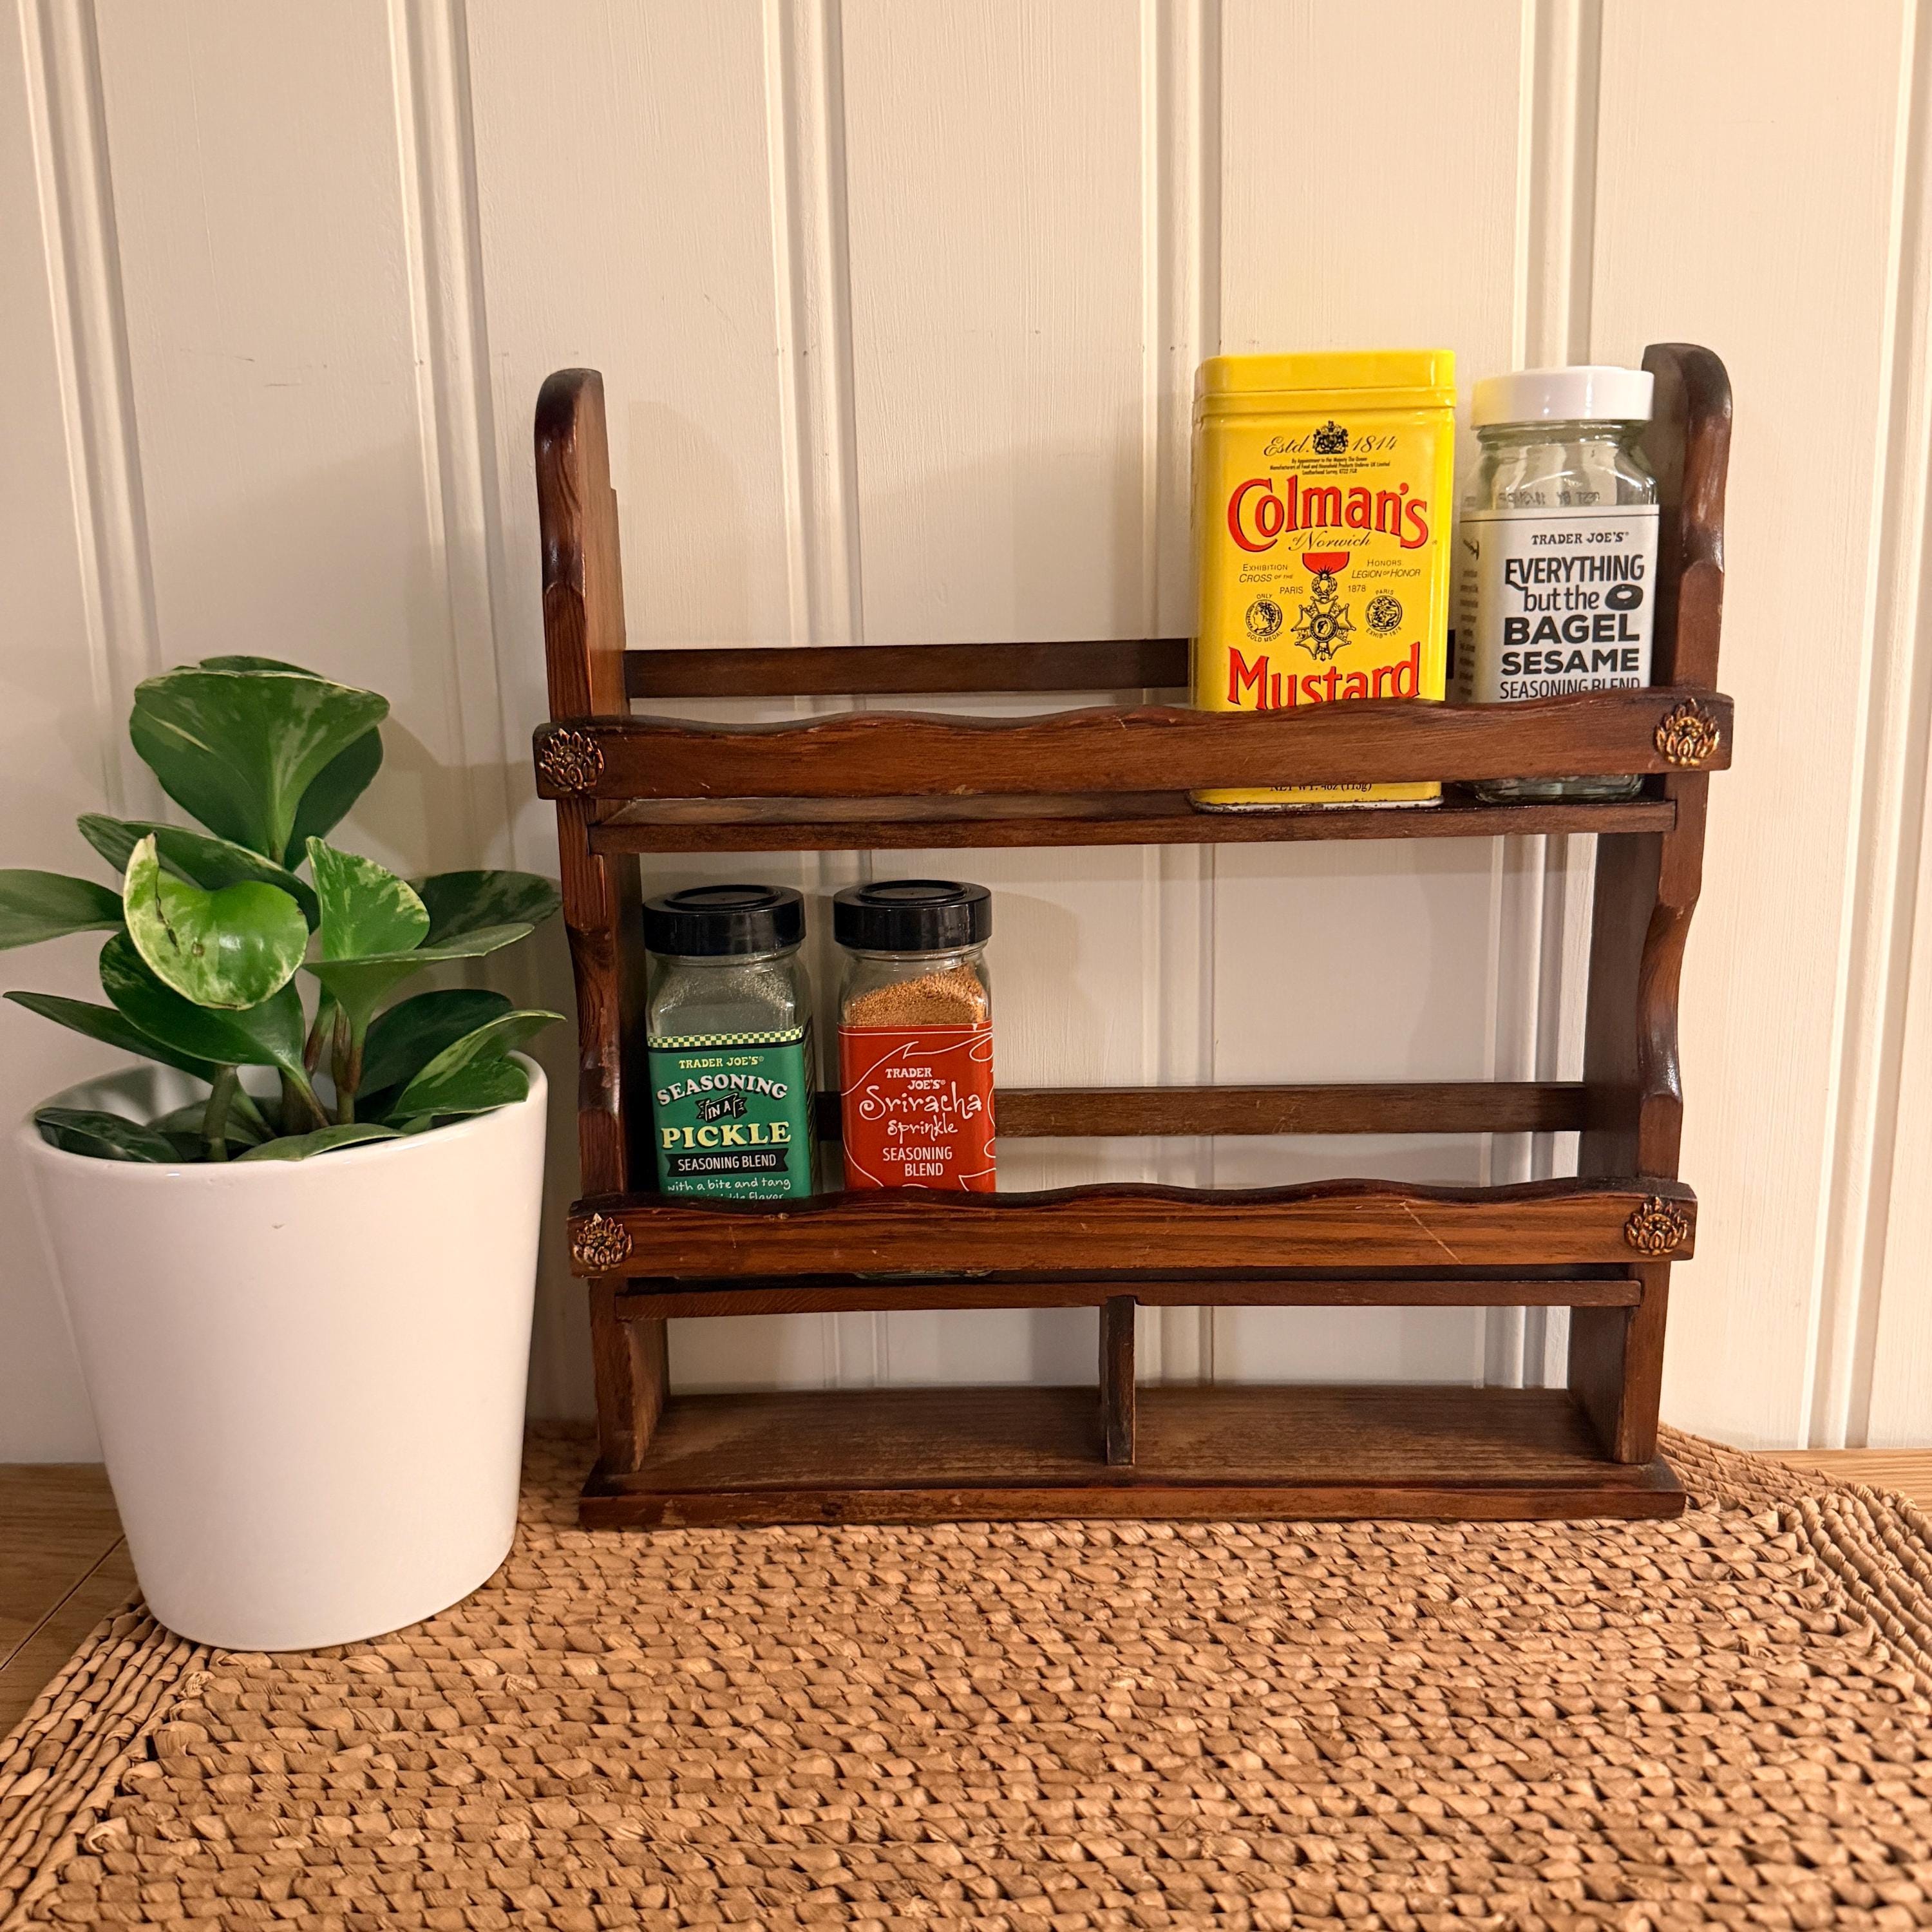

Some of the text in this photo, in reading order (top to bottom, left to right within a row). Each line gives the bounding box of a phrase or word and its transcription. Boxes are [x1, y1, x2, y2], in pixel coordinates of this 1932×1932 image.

[1264, 435, 1398, 457] Estd. 1814
[1227, 475, 1428, 553] Colman's
[1289, 530, 1371, 551] Norwich
[1531, 533, 1582, 545] TRADER
[1351, 569, 1382, 578] LEGION
[1390, 569, 1421, 577] HONOR
[1505, 554, 1644, 585] EVERYTHING
[1524, 585, 1600, 612] but the
[1246, 630, 1283, 642] GOLD MEDAL
[1503, 613, 1640, 646] BAGEL
[1501, 649, 1640, 676] SESAME
[1227, 641, 1421, 710] Mustard
[1500, 679, 1588, 699] SEASONING
[679, 1057, 723, 1069] TRADER
[885, 1067, 933, 1079] TRADER
[656, 1073, 789, 1106] SEASONING
[708, 1100, 731, 1119] IN A
[859, 1081, 982, 1121] Sriracha
[661, 1121, 791, 1150] PICKLE
[677, 1154, 777, 1171] SEASONING BLEND
[882, 1146, 952, 1162] SEASONING
[904, 1163, 943, 1177] BLEND
[667, 1180, 694, 1191] with
[708, 1179, 732, 1190] bite
[734, 1178, 759, 1188] and
[761, 1177, 791, 1190] tang
